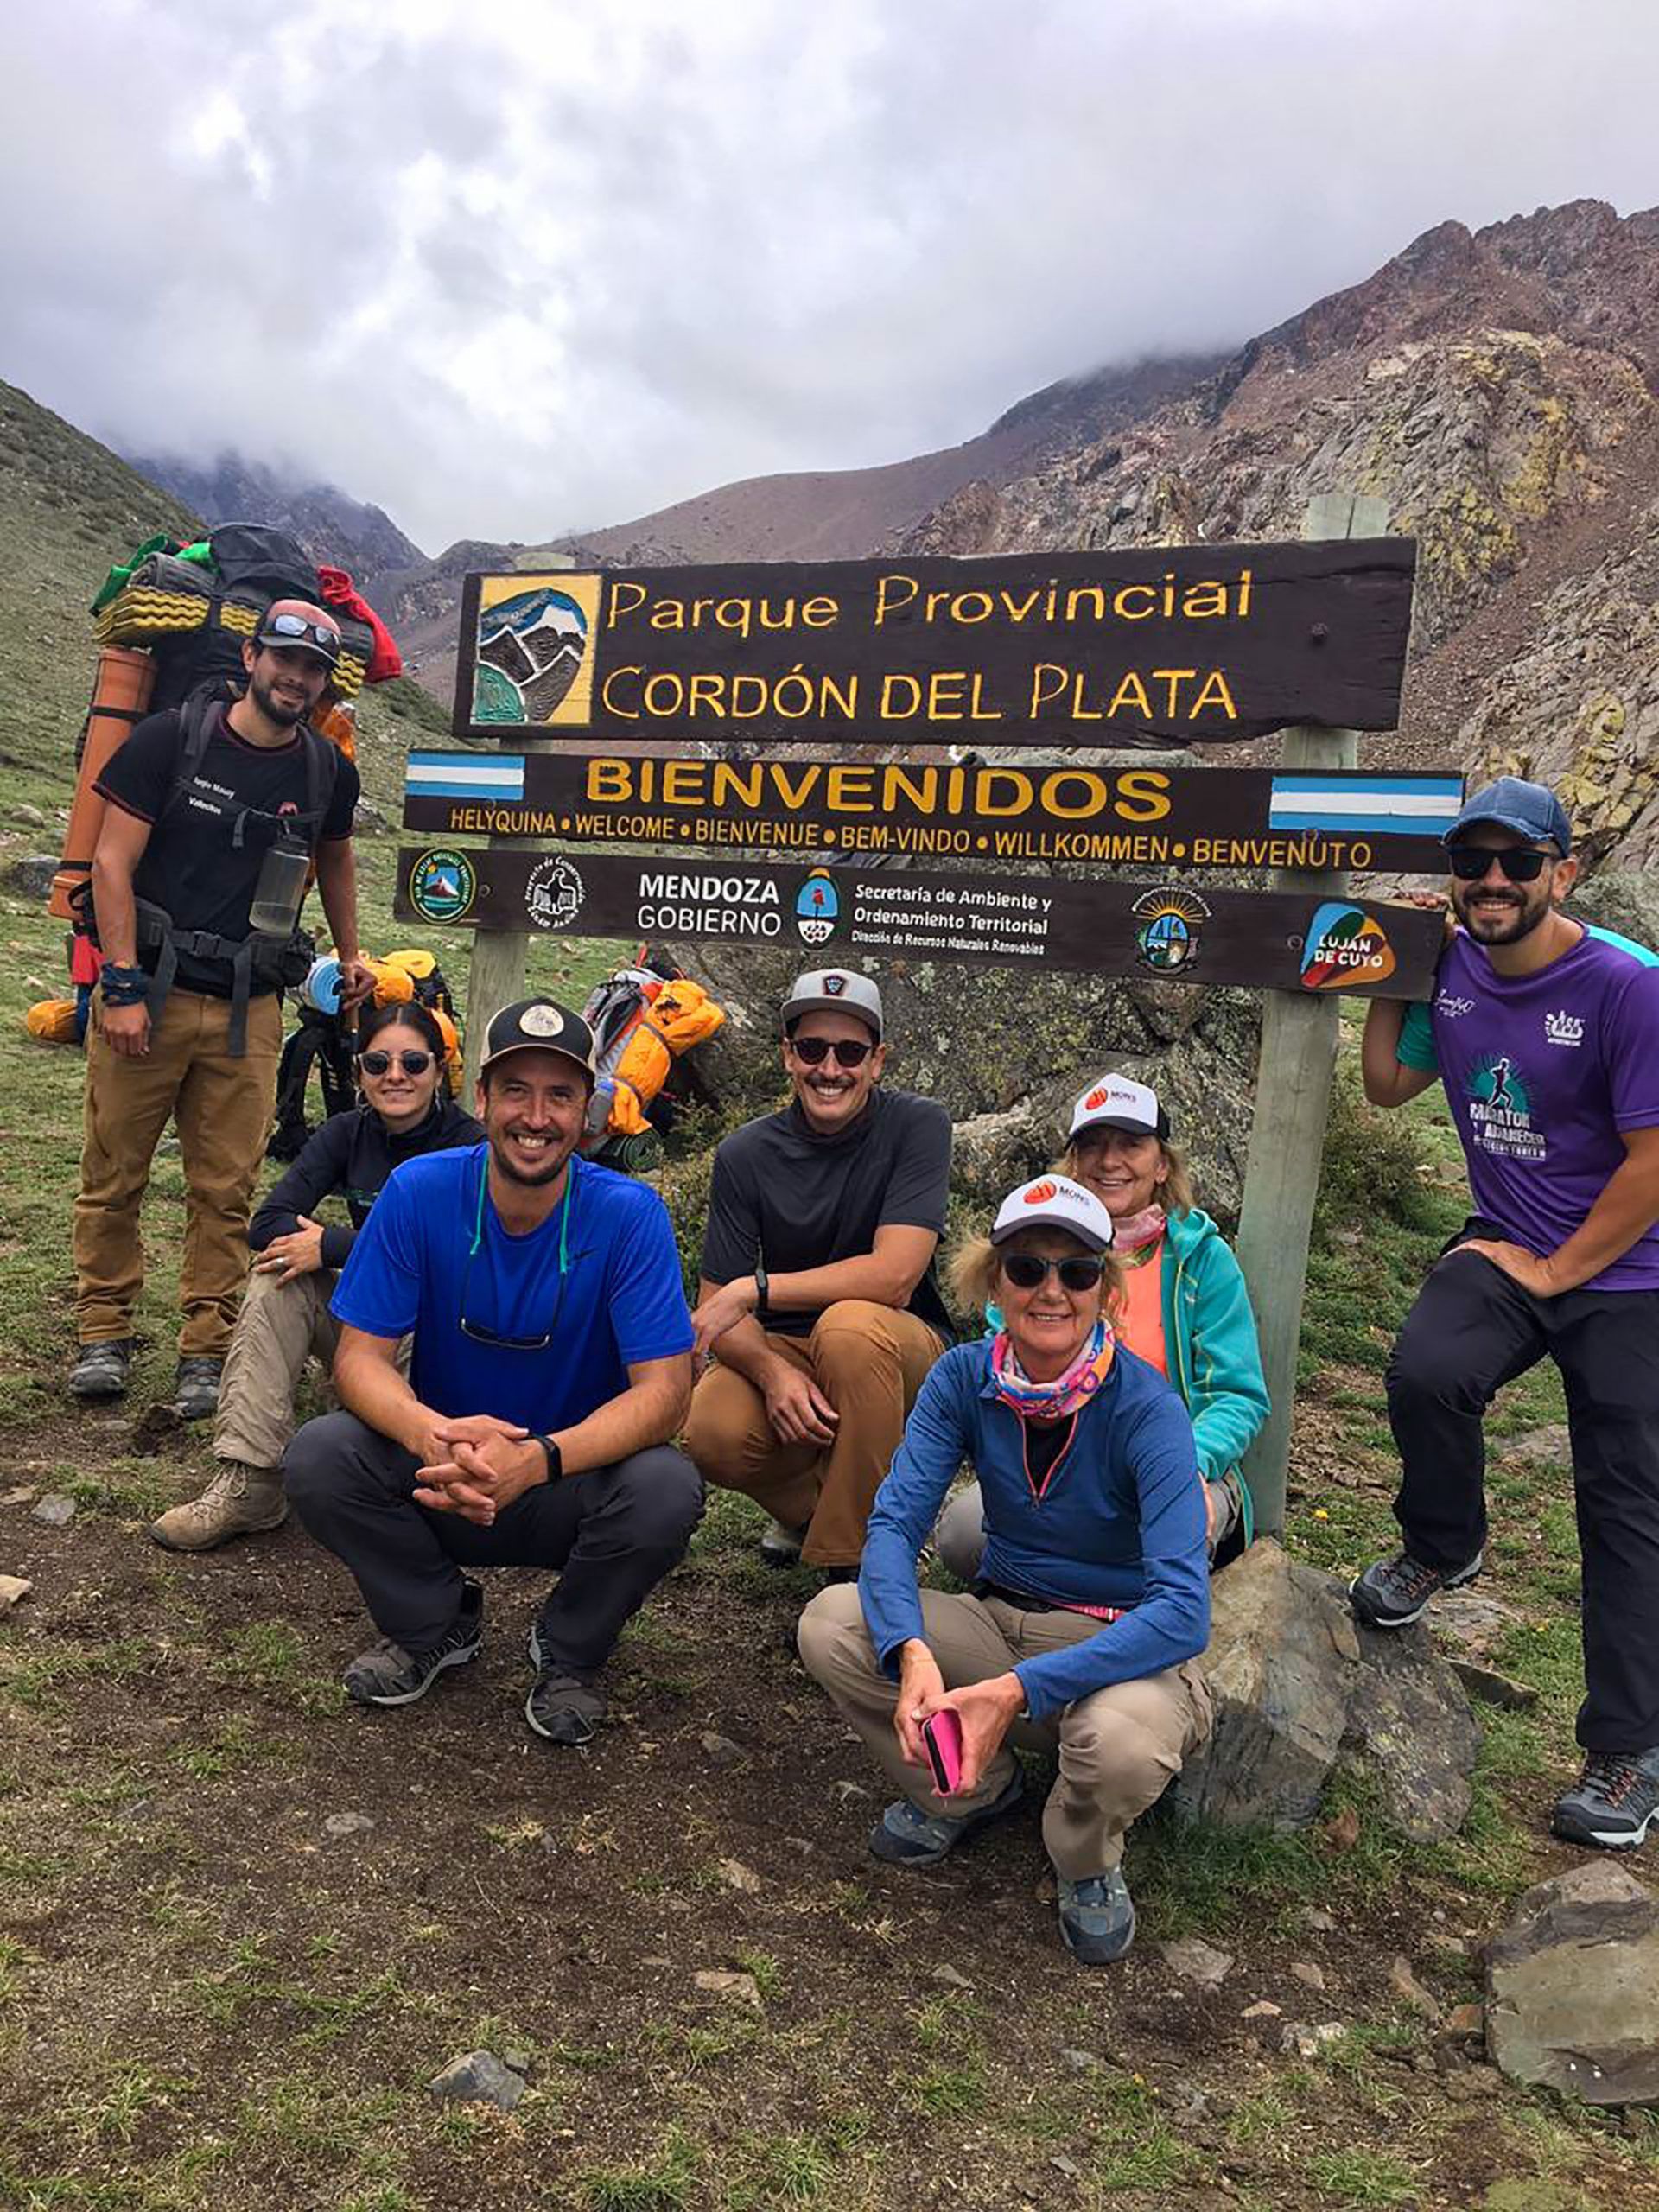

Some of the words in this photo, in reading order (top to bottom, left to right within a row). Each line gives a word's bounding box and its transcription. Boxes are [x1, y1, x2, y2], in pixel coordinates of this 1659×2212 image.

[607, 583, 838, 638] Parque
[875, 569, 1252, 626] Provincial
[602, 663, 858, 720] CORDÓN
[880, 672, 1002, 720] DEL
[1028, 663, 1237, 720] PLATA
[587, 758, 1172, 822] BIENVENIDOS
[450, 808, 556, 834] HELYQUINA
[575, 813, 675, 841] WELCOME
[695, 819, 818, 847] BIENVENUE
[841, 826, 969, 853] BEM-VINDO
[995, 831, 1169, 861] WILLKOMMEN
[1192, 836, 1372, 868] BENVENUTO
[639, 874, 779, 904] MENDOZA
[855, 883, 931, 903] Secretaría
[935, 887, 956, 904] de
[958, 890, 1038, 911] Ambiente
[1041, 898, 1052, 913] y
[637, 904, 781, 938] GOBIERNO
[853, 906, 965, 931] Ordenamiento
[969, 913, 1048, 936] Territorial
[893, 932, 904, 946] de
[905, 932, 946, 948] Recursos
[1314, 949, 1336, 964] DE
[1338, 952, 1383, 969] CUYO
